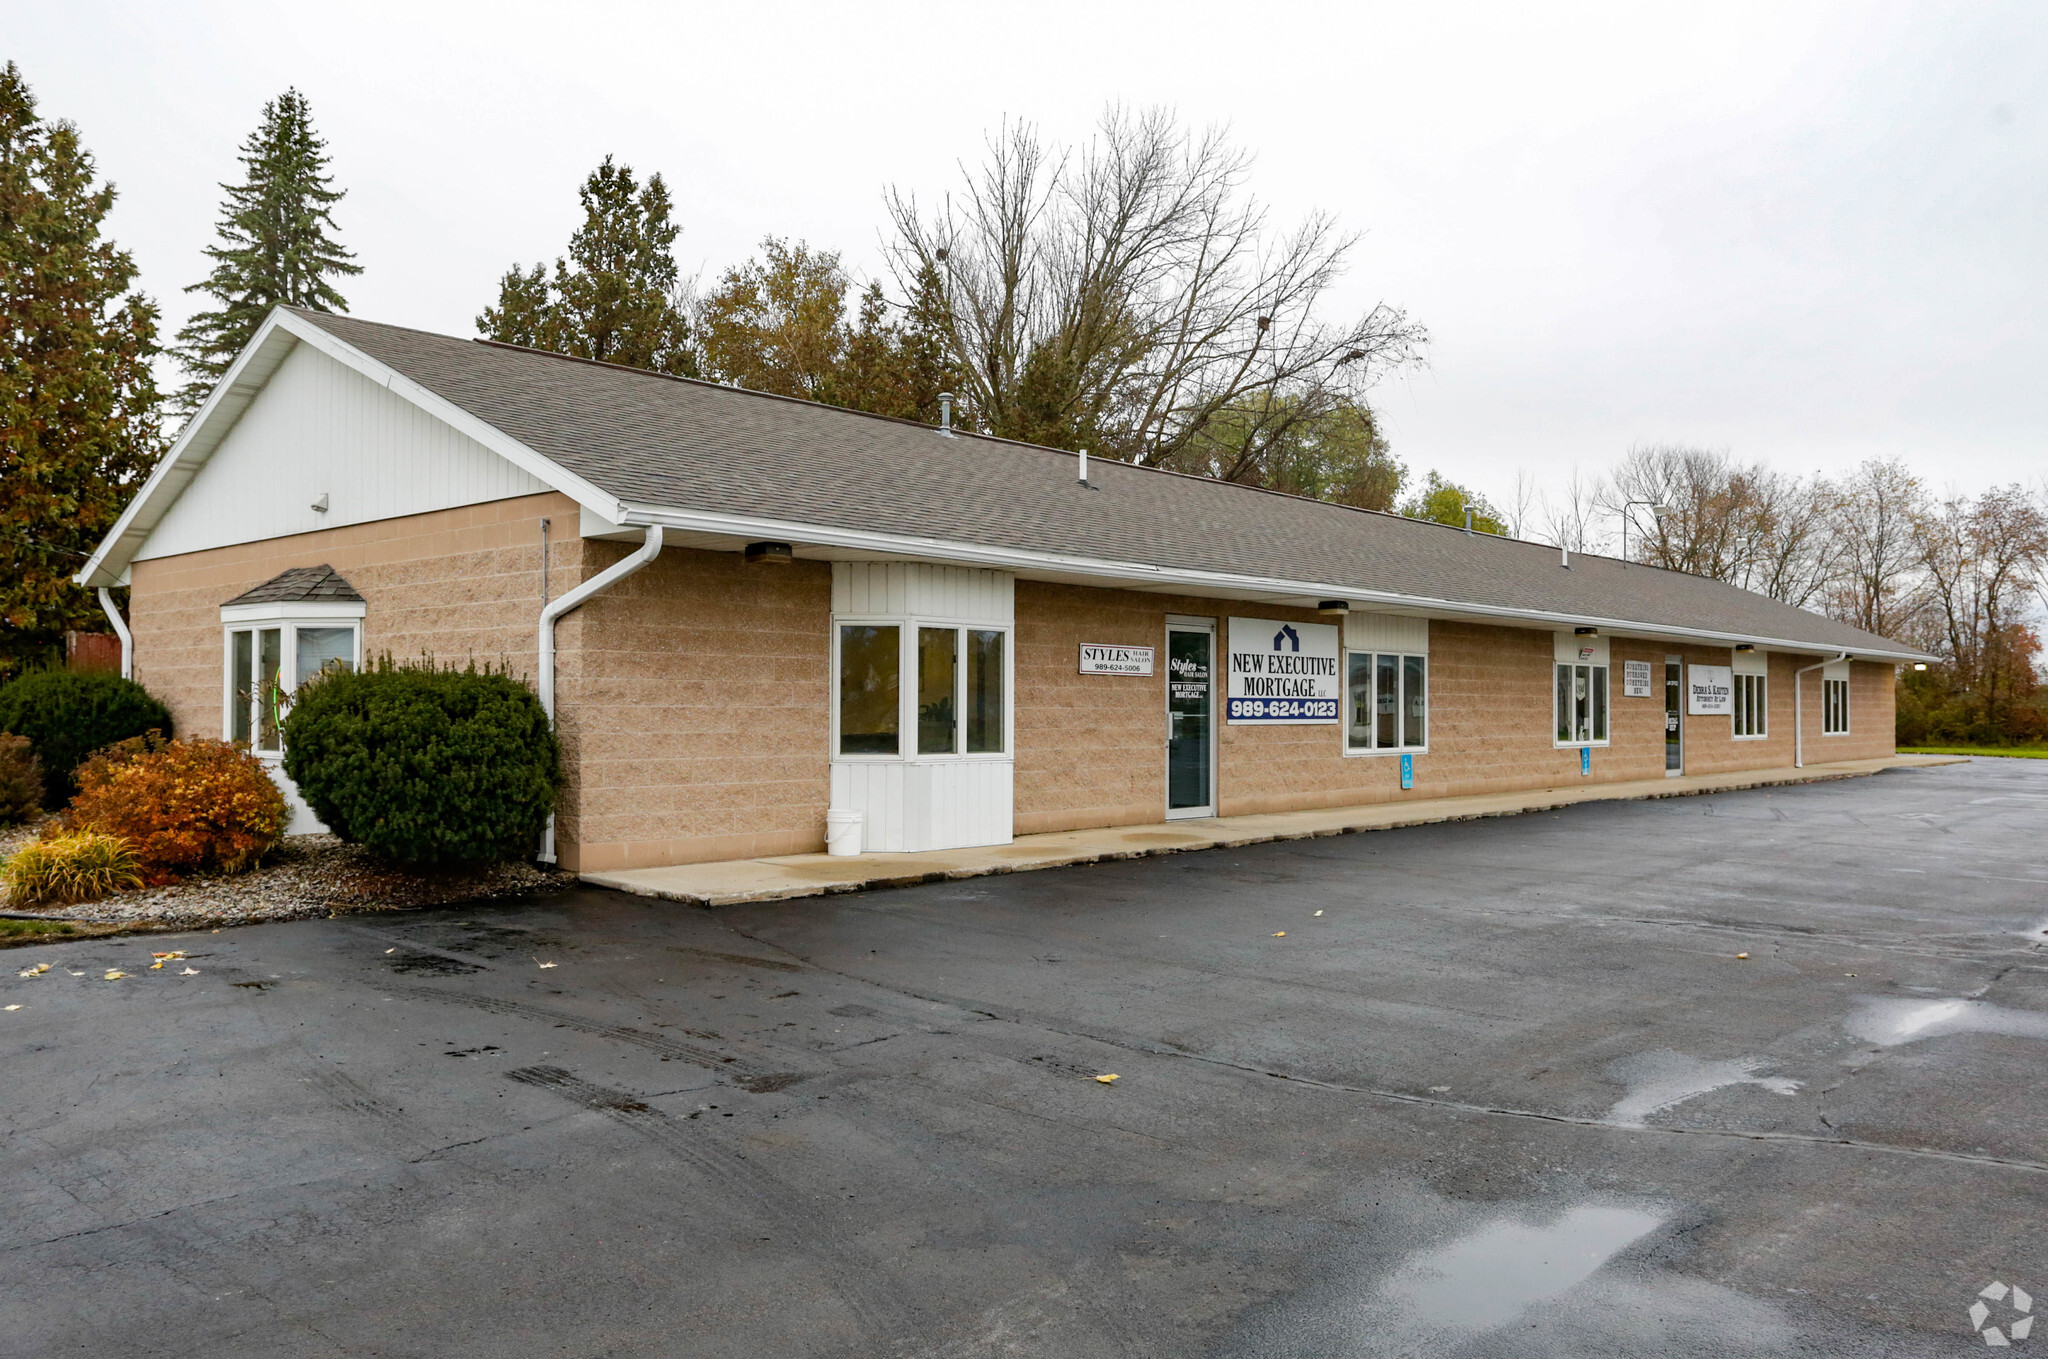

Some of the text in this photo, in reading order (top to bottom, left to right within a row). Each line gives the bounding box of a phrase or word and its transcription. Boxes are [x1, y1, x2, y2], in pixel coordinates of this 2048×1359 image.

[1084, 648, 1130, 662] STYLES
[1094, 663, 1140, 672] 989-624-5006
[1170, 658, 1197, 674] Styles
[1233, 653, 1336, 676] NEW EXECUTIVE
[1183, 684, 1207, 692] EXECUTIVE
[1243, 677, 1316, 697] MORTGAGE
[1175, 691, 1199, 699] MORTGAGE
[1231, 700, 1337, 717] 989-624-0123
